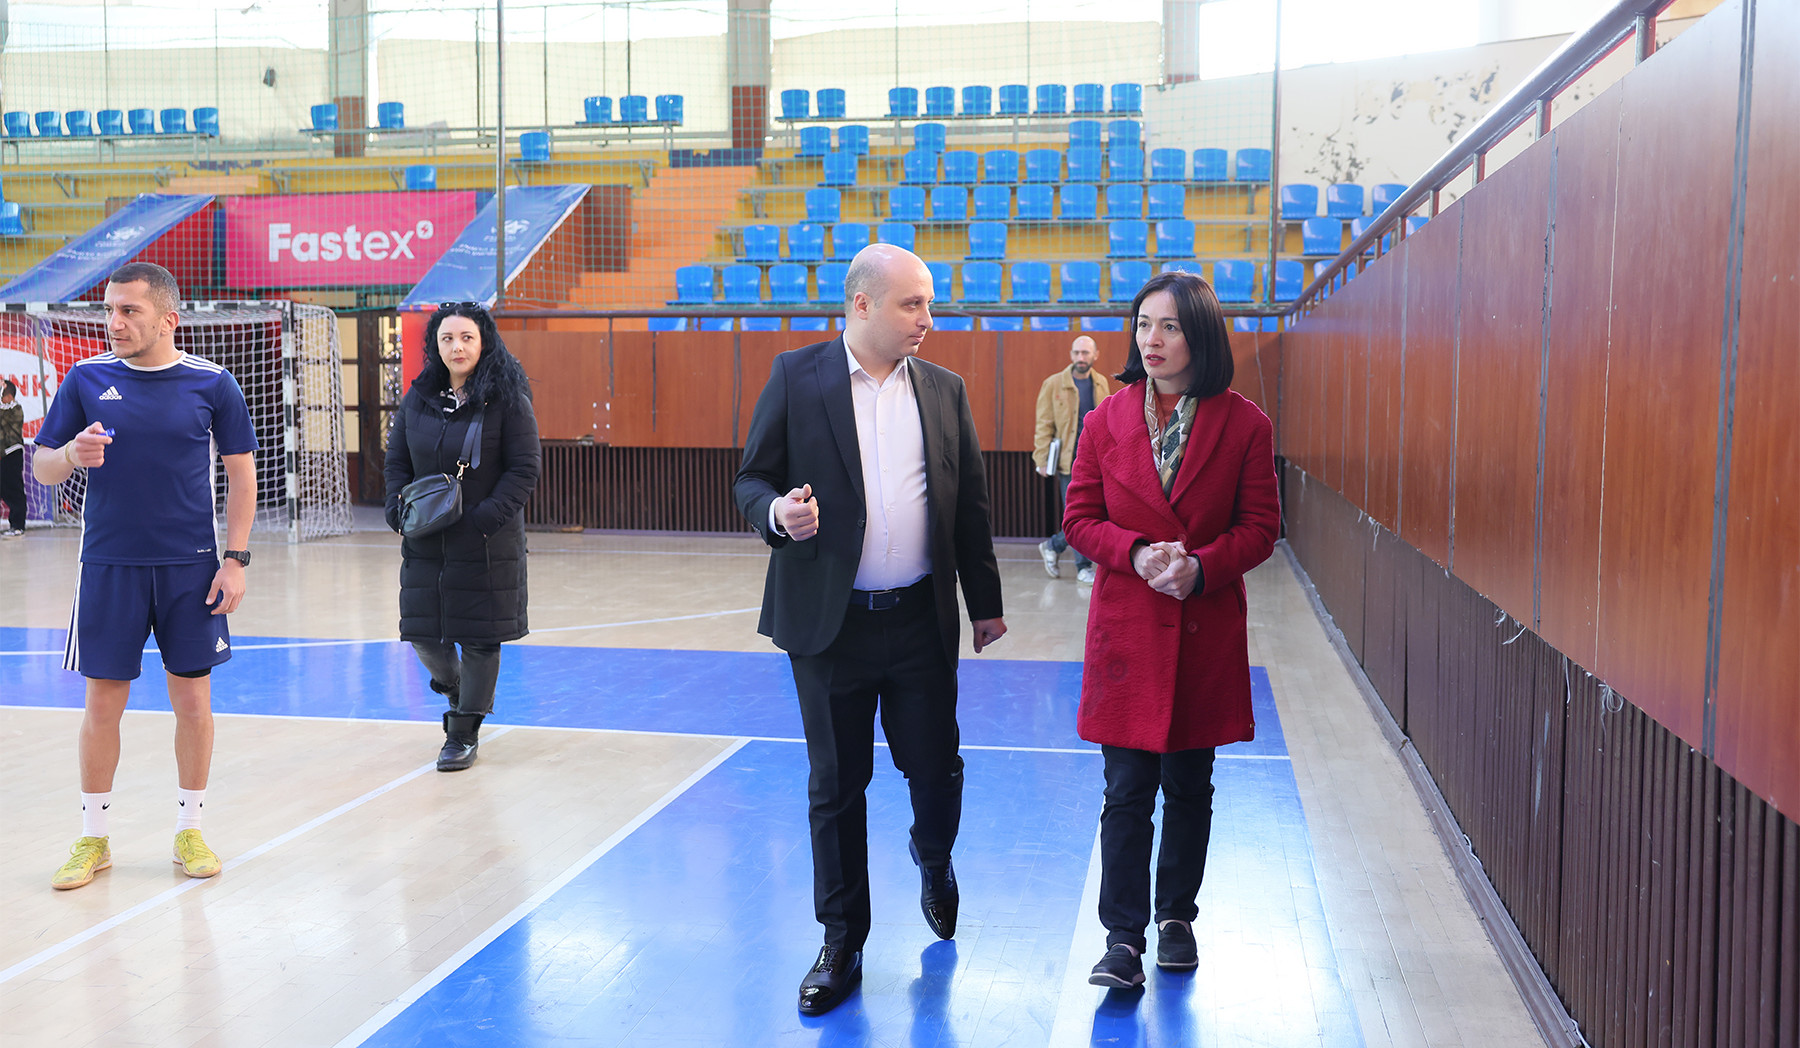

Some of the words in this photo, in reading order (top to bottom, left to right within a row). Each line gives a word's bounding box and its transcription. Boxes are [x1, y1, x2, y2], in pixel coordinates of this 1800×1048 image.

[268, 222, 415, 262] Fastex
[0, 374, 51, 397] NK
[98, 392, 123, 401] adidas
